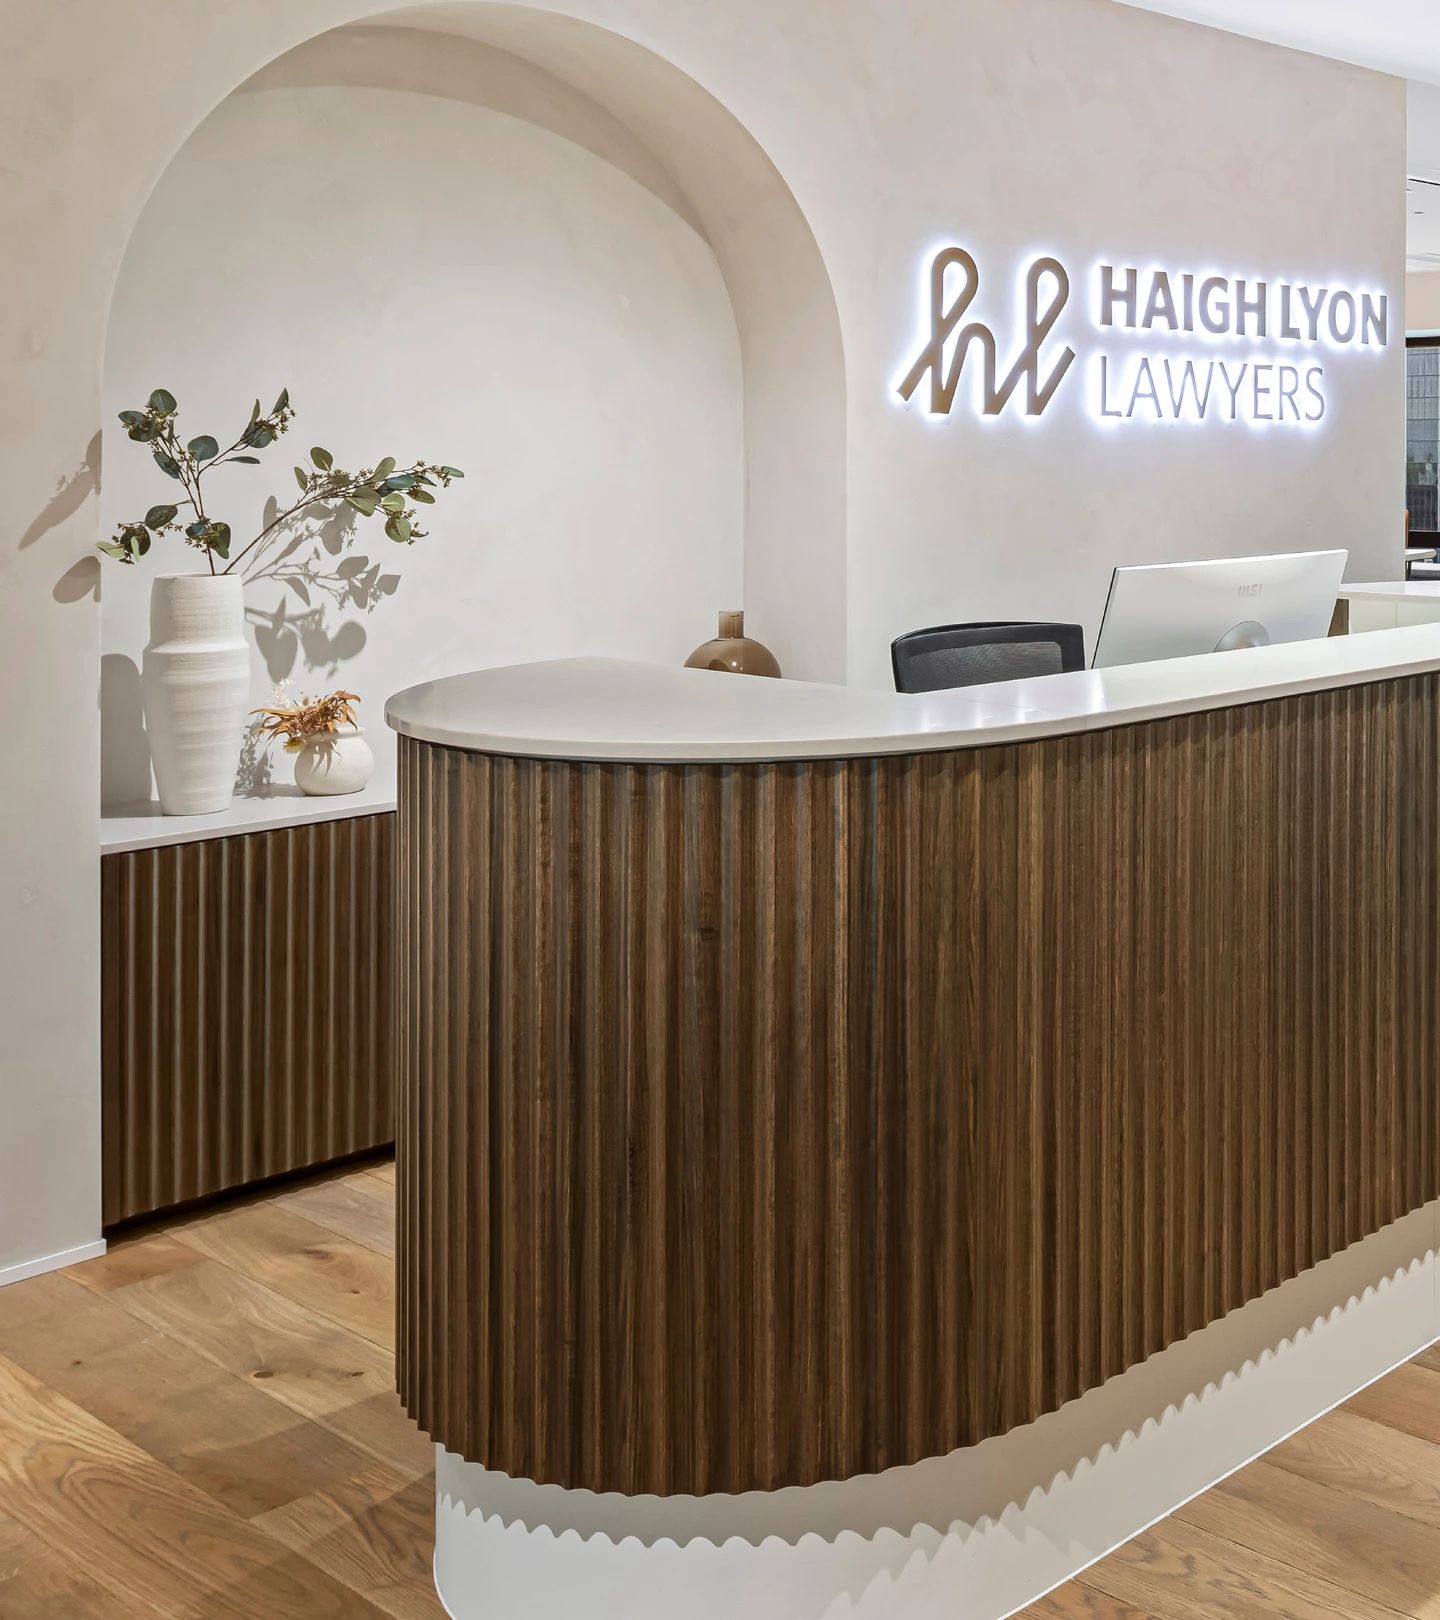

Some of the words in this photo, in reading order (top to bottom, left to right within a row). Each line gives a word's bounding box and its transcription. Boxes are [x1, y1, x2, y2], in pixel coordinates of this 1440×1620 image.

[1099, 265, 1267, 338] HAIGH
[1279, 284, 1388, 346] LYON
[1100, 356, 1325, 421] LAWYERS
